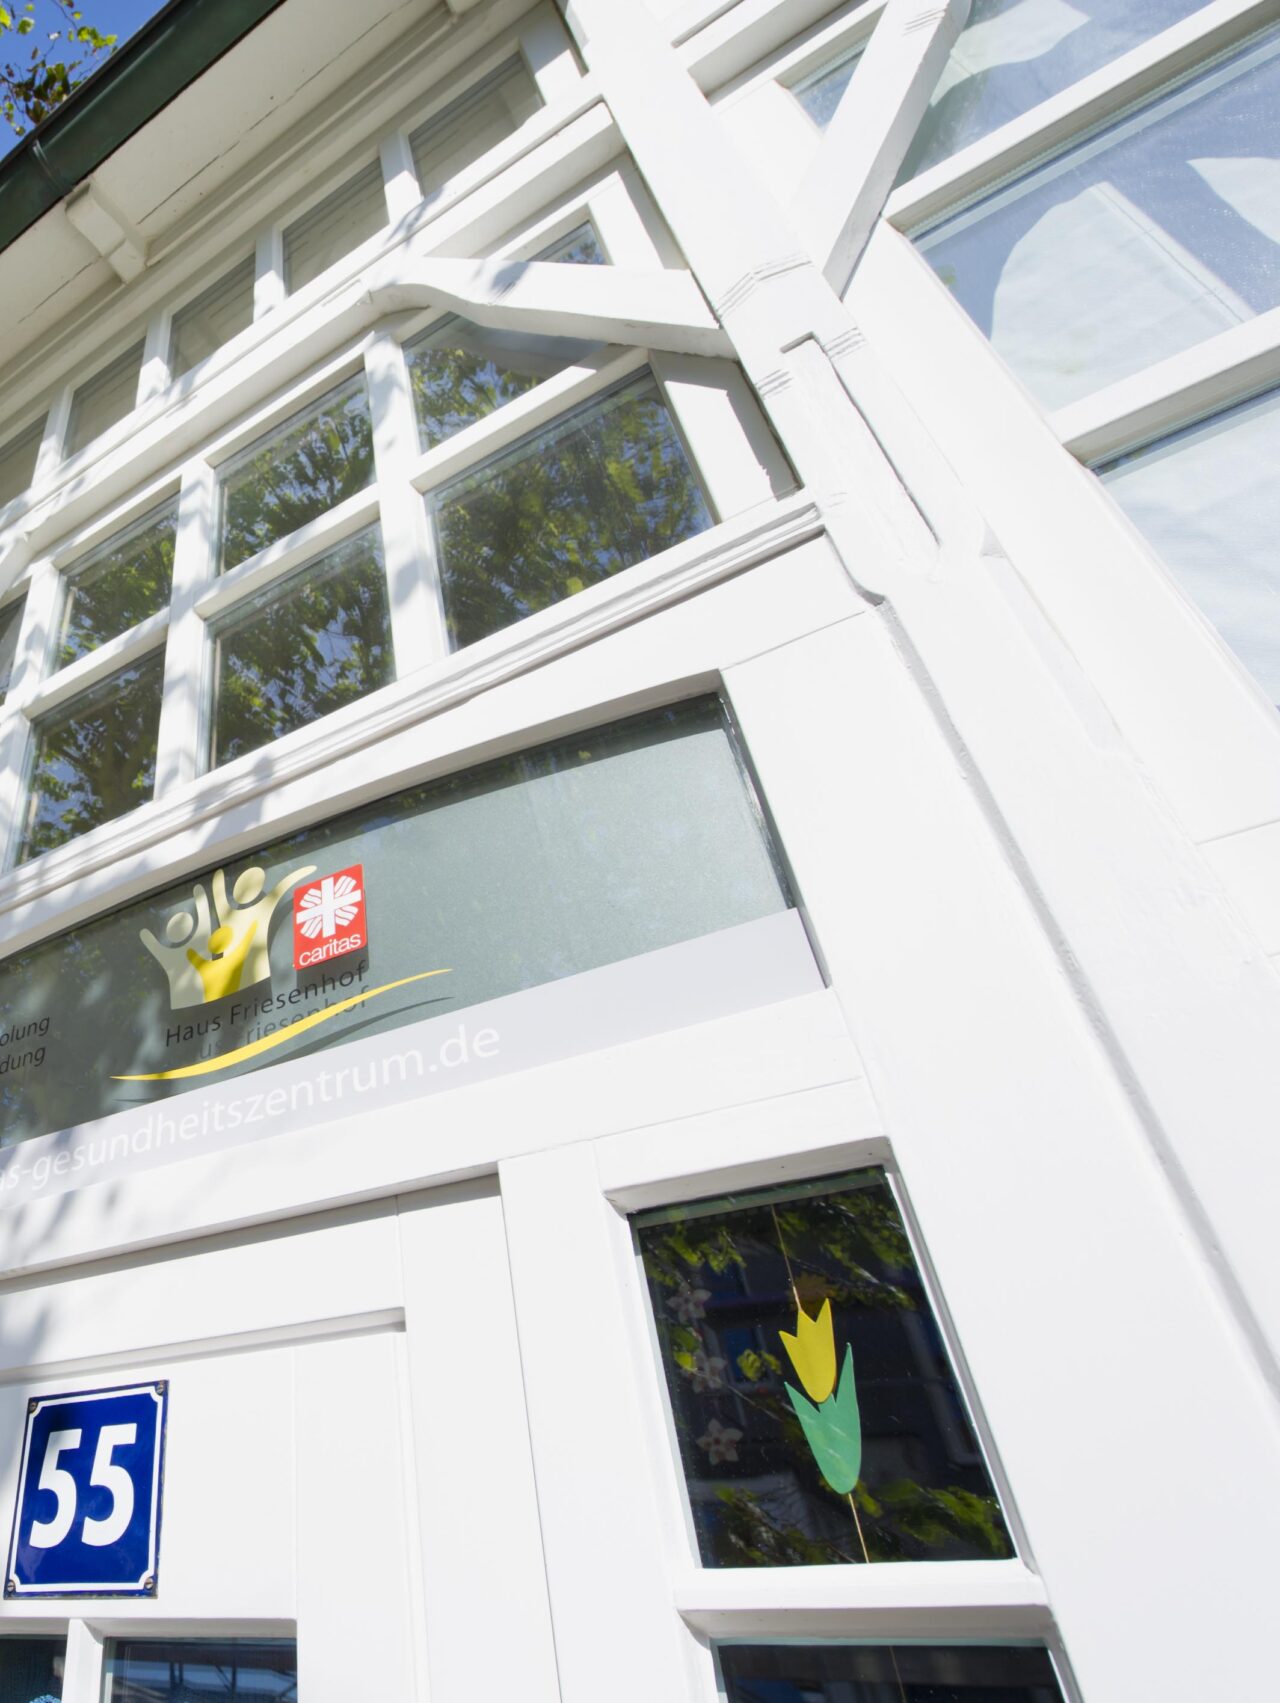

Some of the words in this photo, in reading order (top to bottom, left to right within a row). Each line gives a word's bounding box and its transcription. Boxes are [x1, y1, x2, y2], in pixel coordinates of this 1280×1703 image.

[299, 933, 362, 966] caritas
[165, 1016, 221, 1047] Haus
[230, 959, 367, 1024] Friesenhof
[29, 1423, 137, 1549] 55
